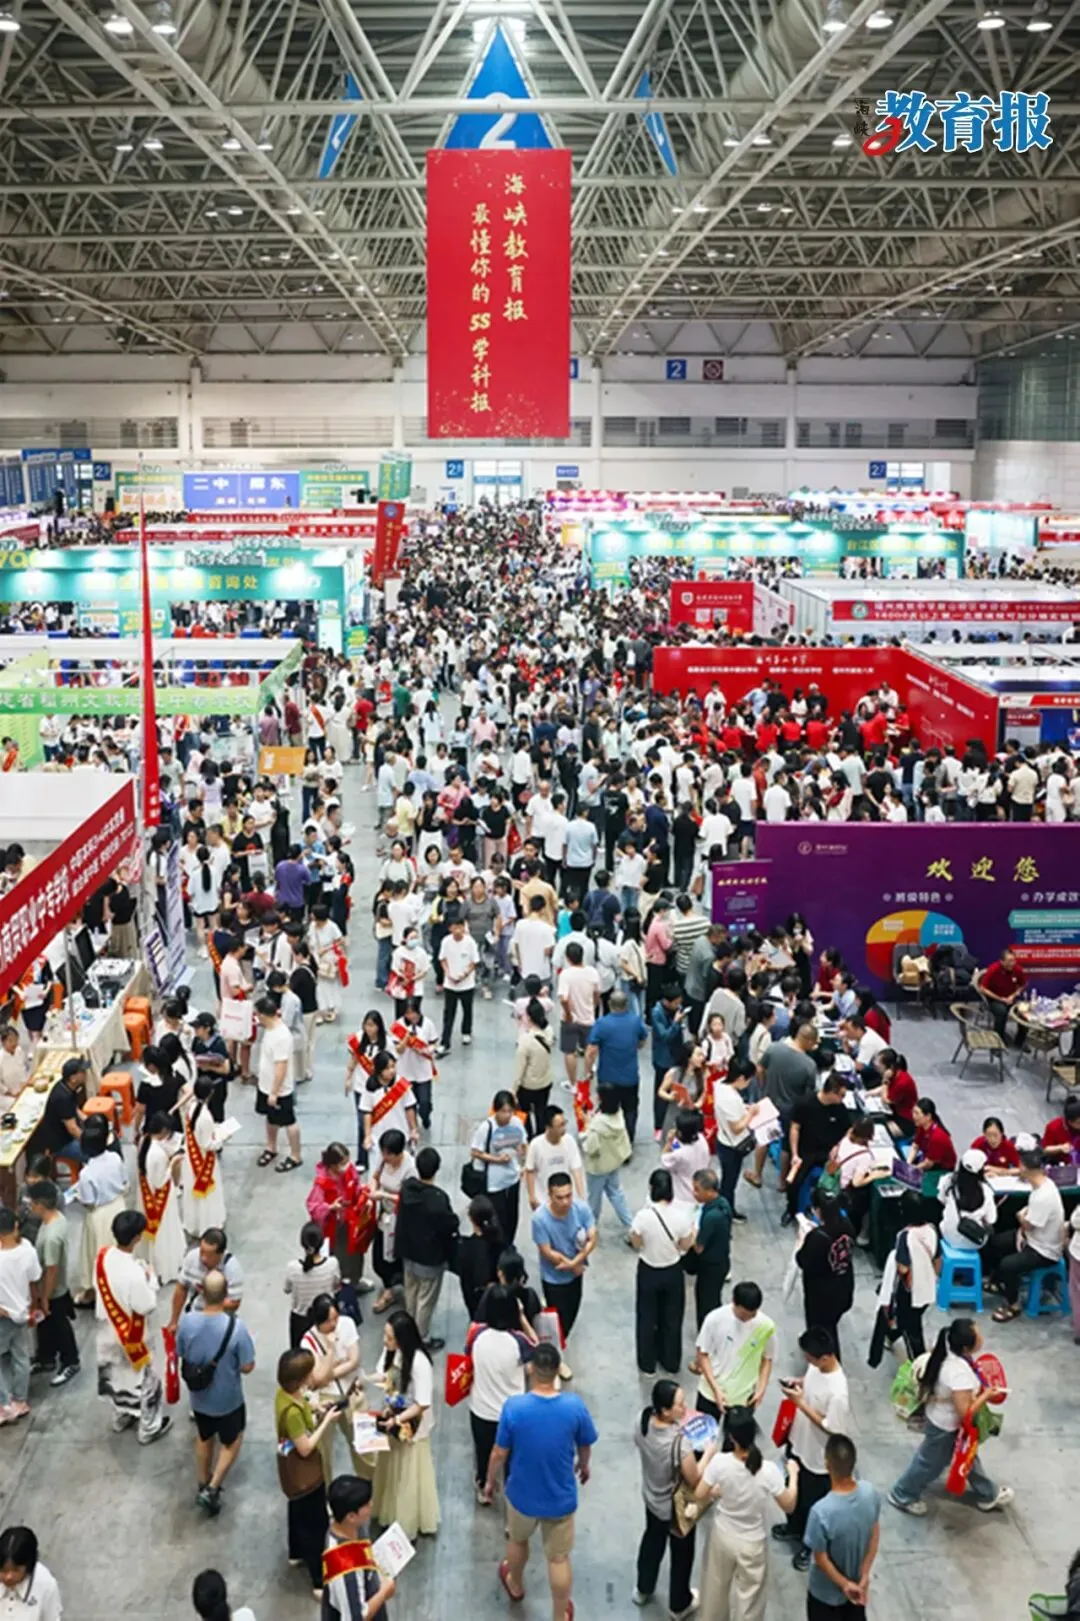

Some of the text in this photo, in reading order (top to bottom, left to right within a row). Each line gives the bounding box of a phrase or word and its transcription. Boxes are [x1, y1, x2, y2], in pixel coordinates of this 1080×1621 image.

[503, 173, 529, 322] 海峡教育报
[670, 361, 683, 378] 2
[925, 856, 1040, 883] 欢迎您
